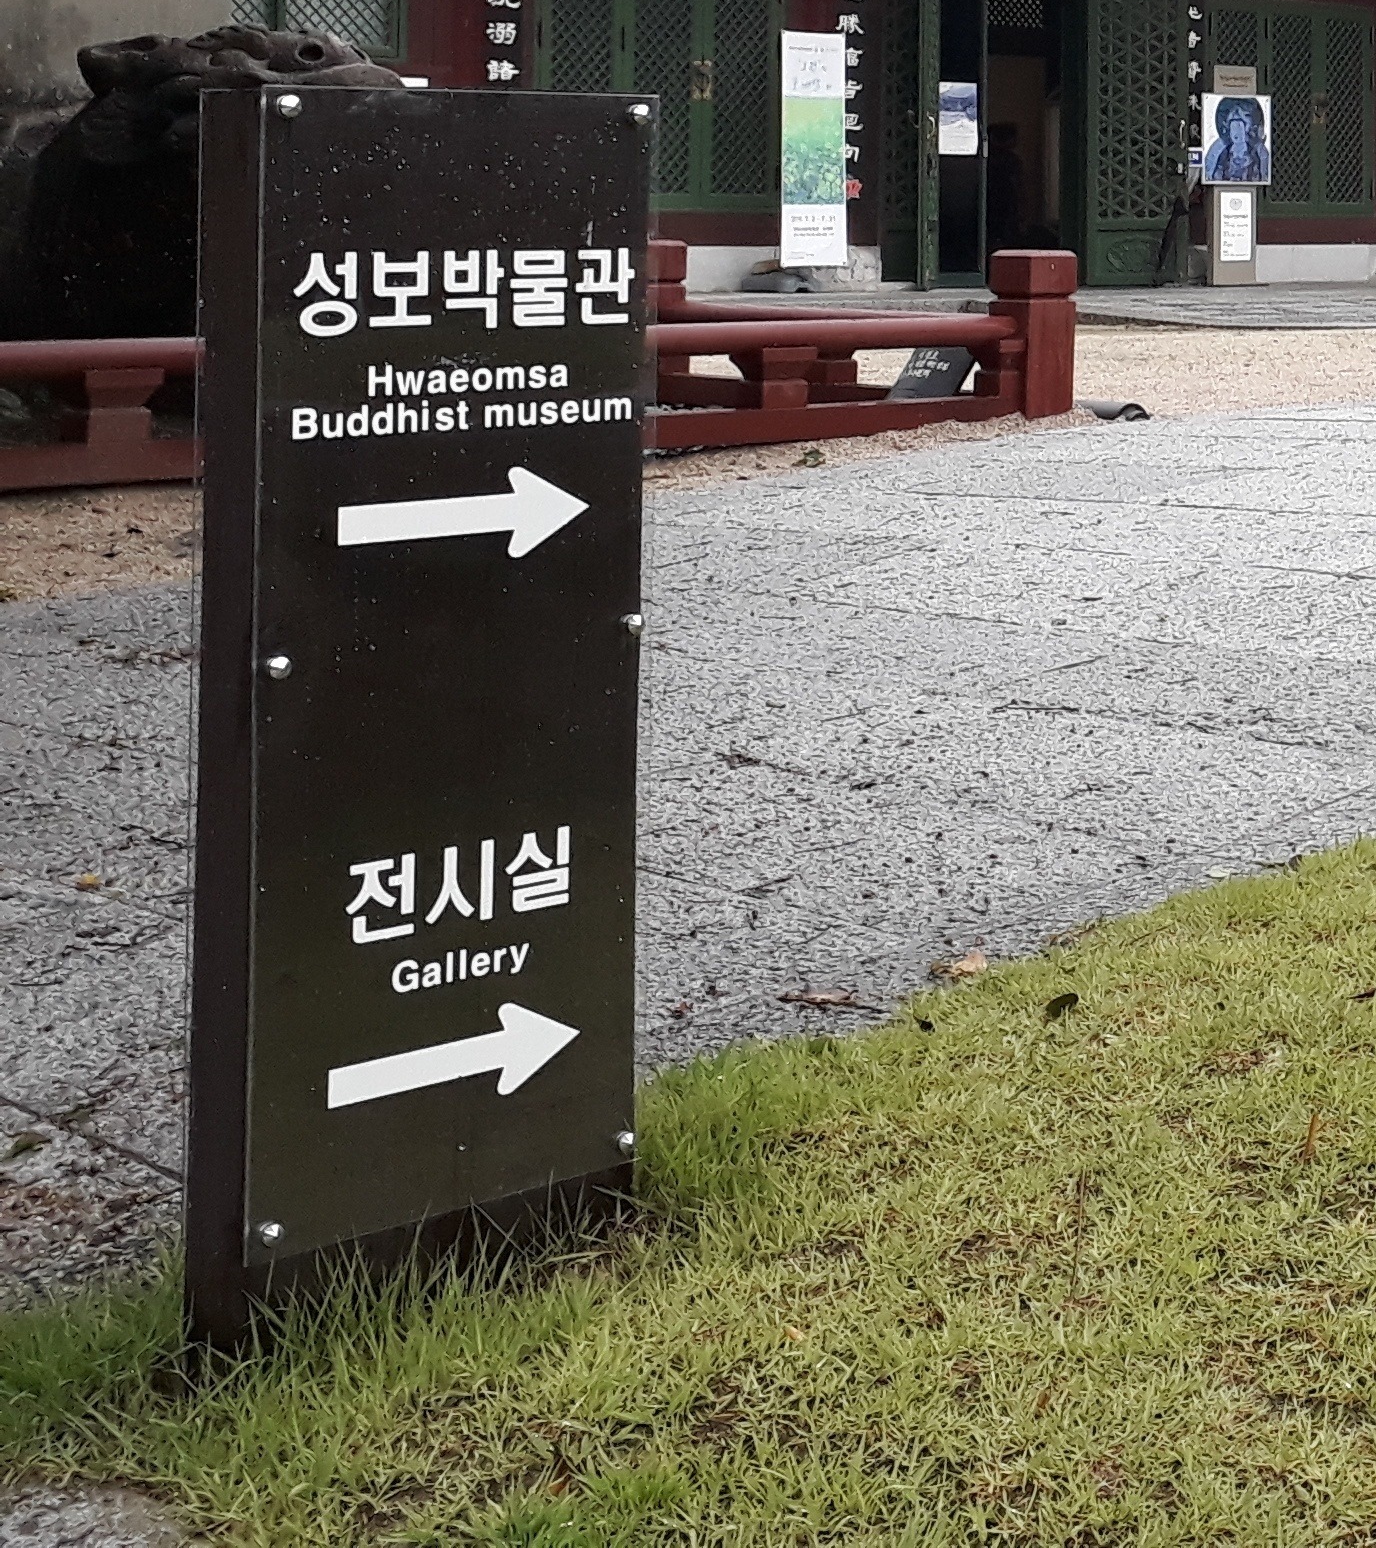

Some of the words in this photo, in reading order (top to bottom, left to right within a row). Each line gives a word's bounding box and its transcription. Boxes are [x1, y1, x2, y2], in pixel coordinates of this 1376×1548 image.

[293, 247, 636, 337] 성보박물관
[368, 364, 568, 396] Hwaeomsa
[292, 399, 470, 441] Buddhist
[484, 396, 633, 430] museum
[344, 825, 572, 945] 전시실
[391, 940, 530, 994] Gallery
